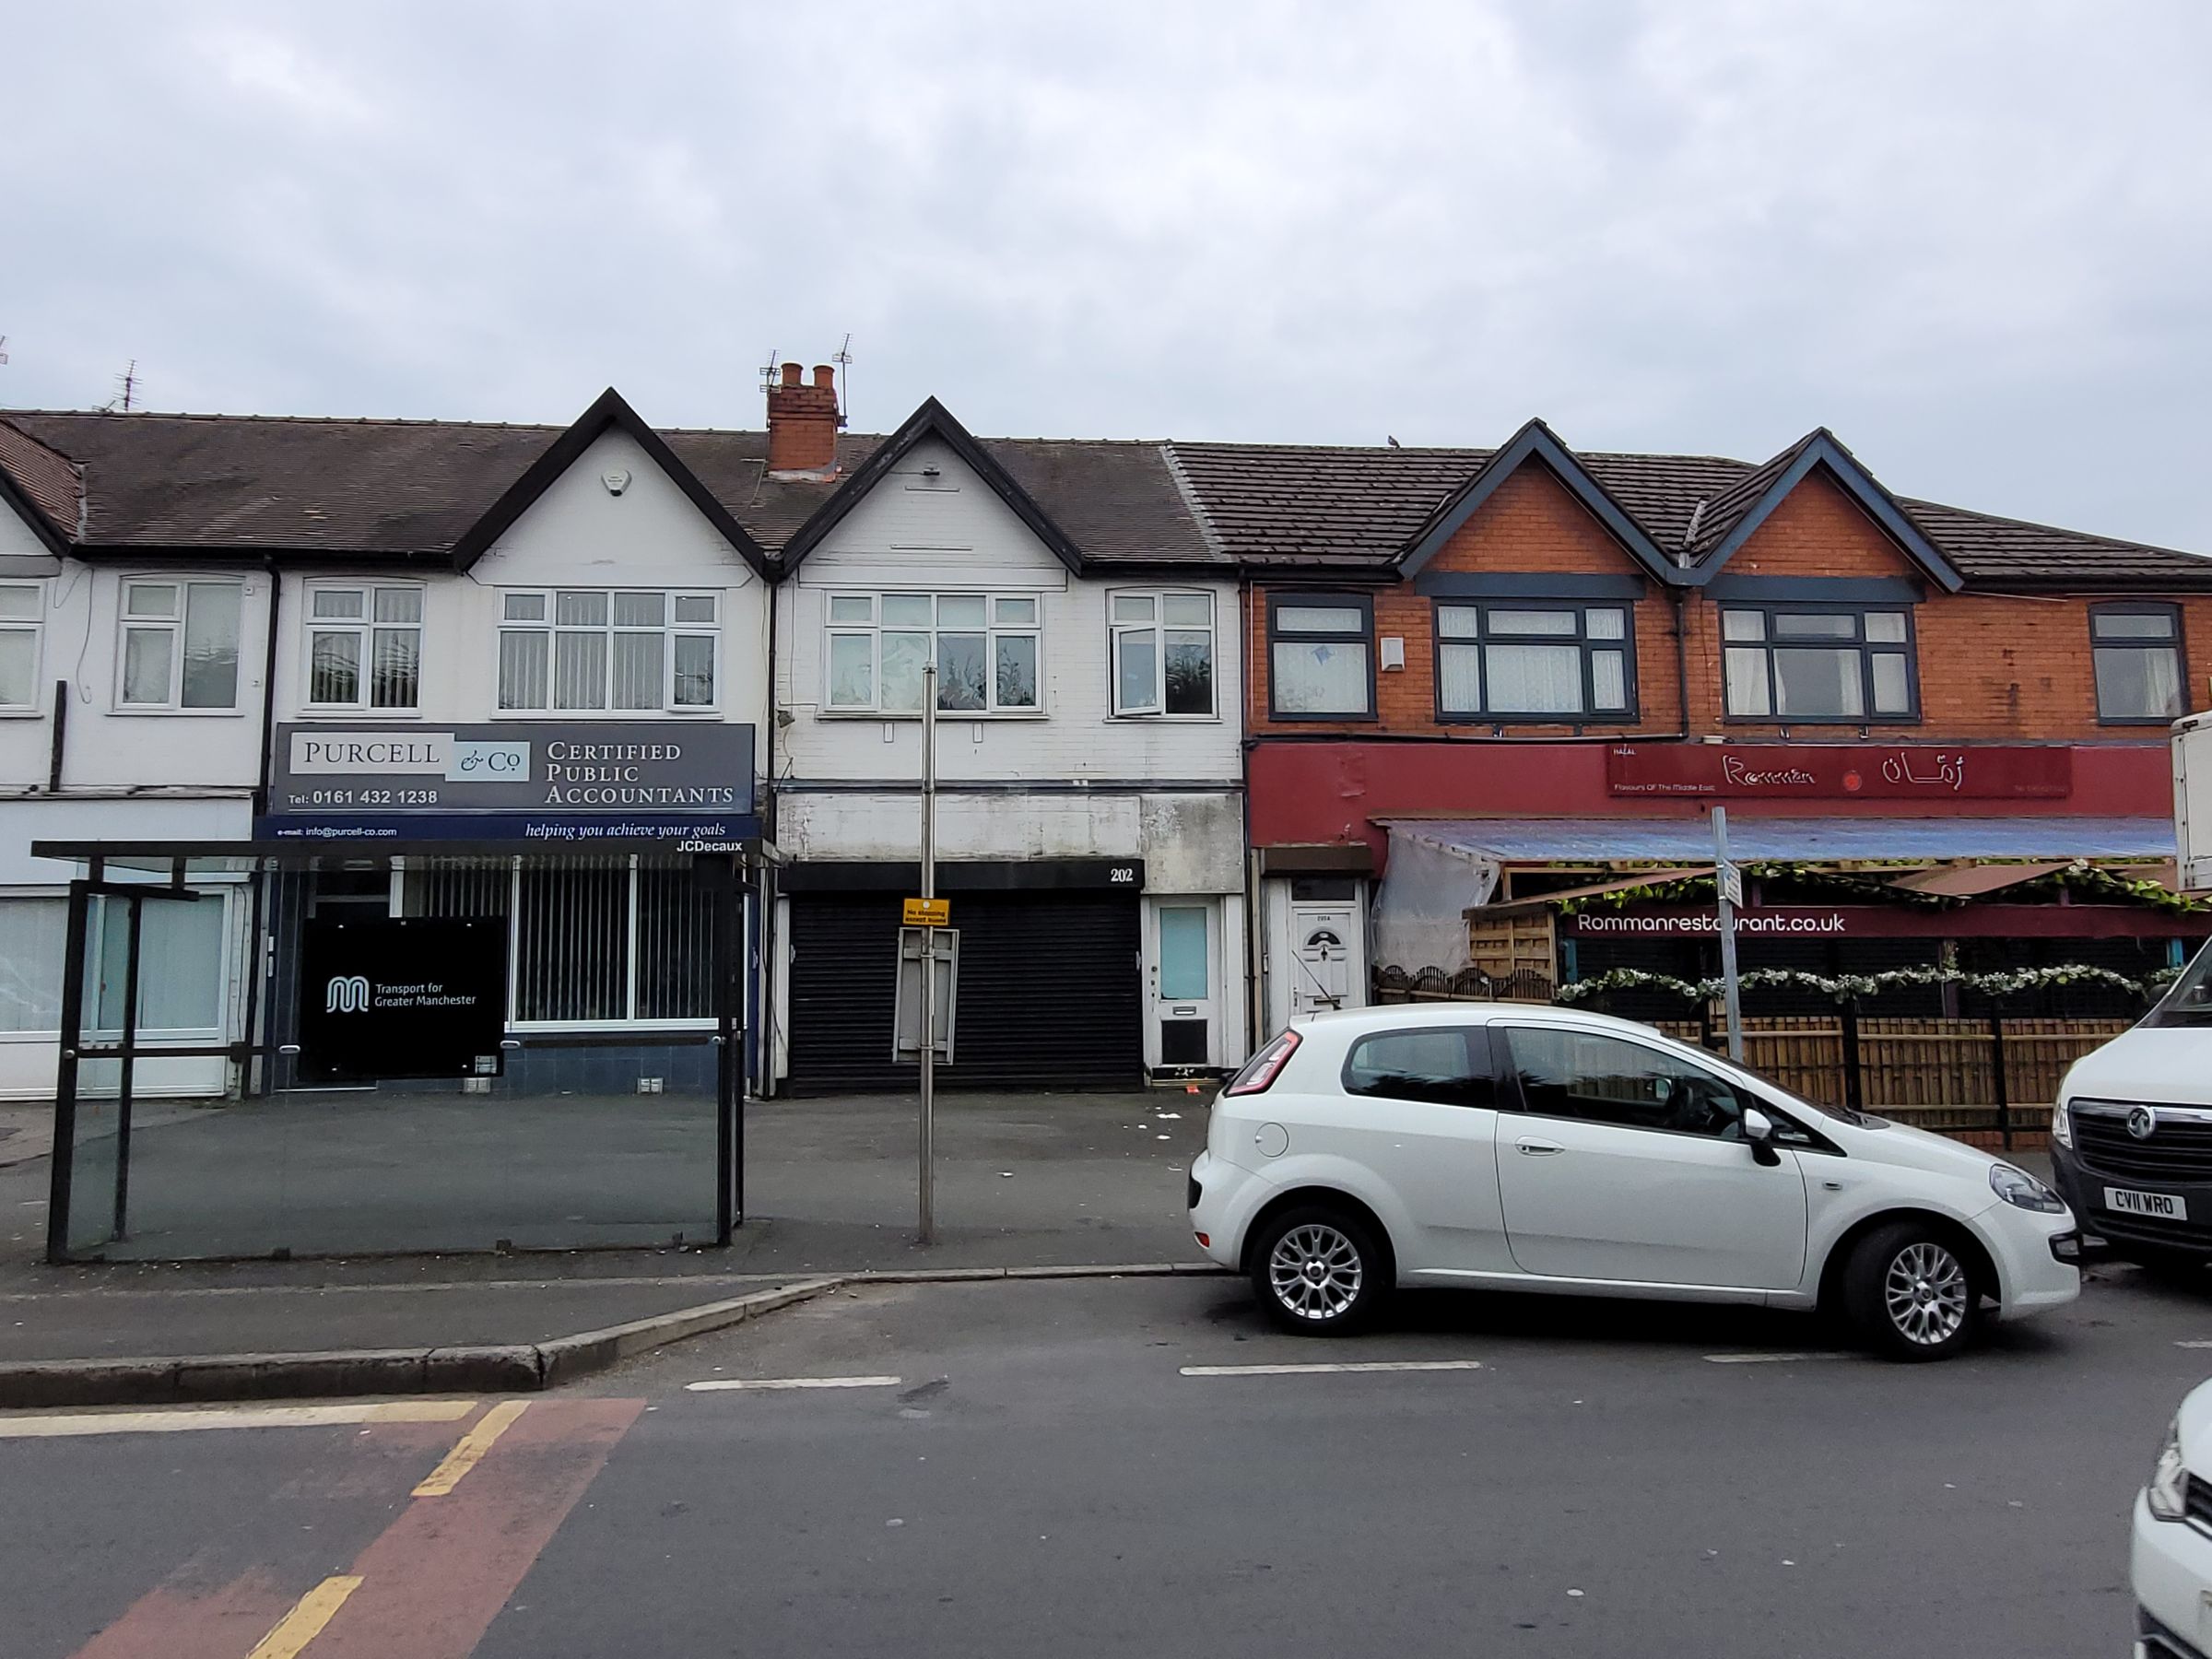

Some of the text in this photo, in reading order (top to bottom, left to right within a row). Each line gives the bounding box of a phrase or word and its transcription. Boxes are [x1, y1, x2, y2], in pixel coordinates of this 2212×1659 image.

[303, 741, 440, 763] PURCELL
[460, 749, 484, 771] &
[547, 741, 681, 760] CERTIFIED
[545, 763, 639, 782] PUBLIC
[288, 790, 438, 805] Tel: 0161 432 1238
[544, 785, 734, 804] ACCOUNTANTS
[306, 827, 397, 838] info@purcell-co.com
[525, 822, 726, 840] helping you achieve your goals
[676, 840, 743, 852] JCDecaux
[1111, 868, 1134, 882] 202
[375, 982, 442, 995] Transport for
[374, 995, 477, 1006] Greater Manchester
[2115, 1190, 2140, 1211] CV11
